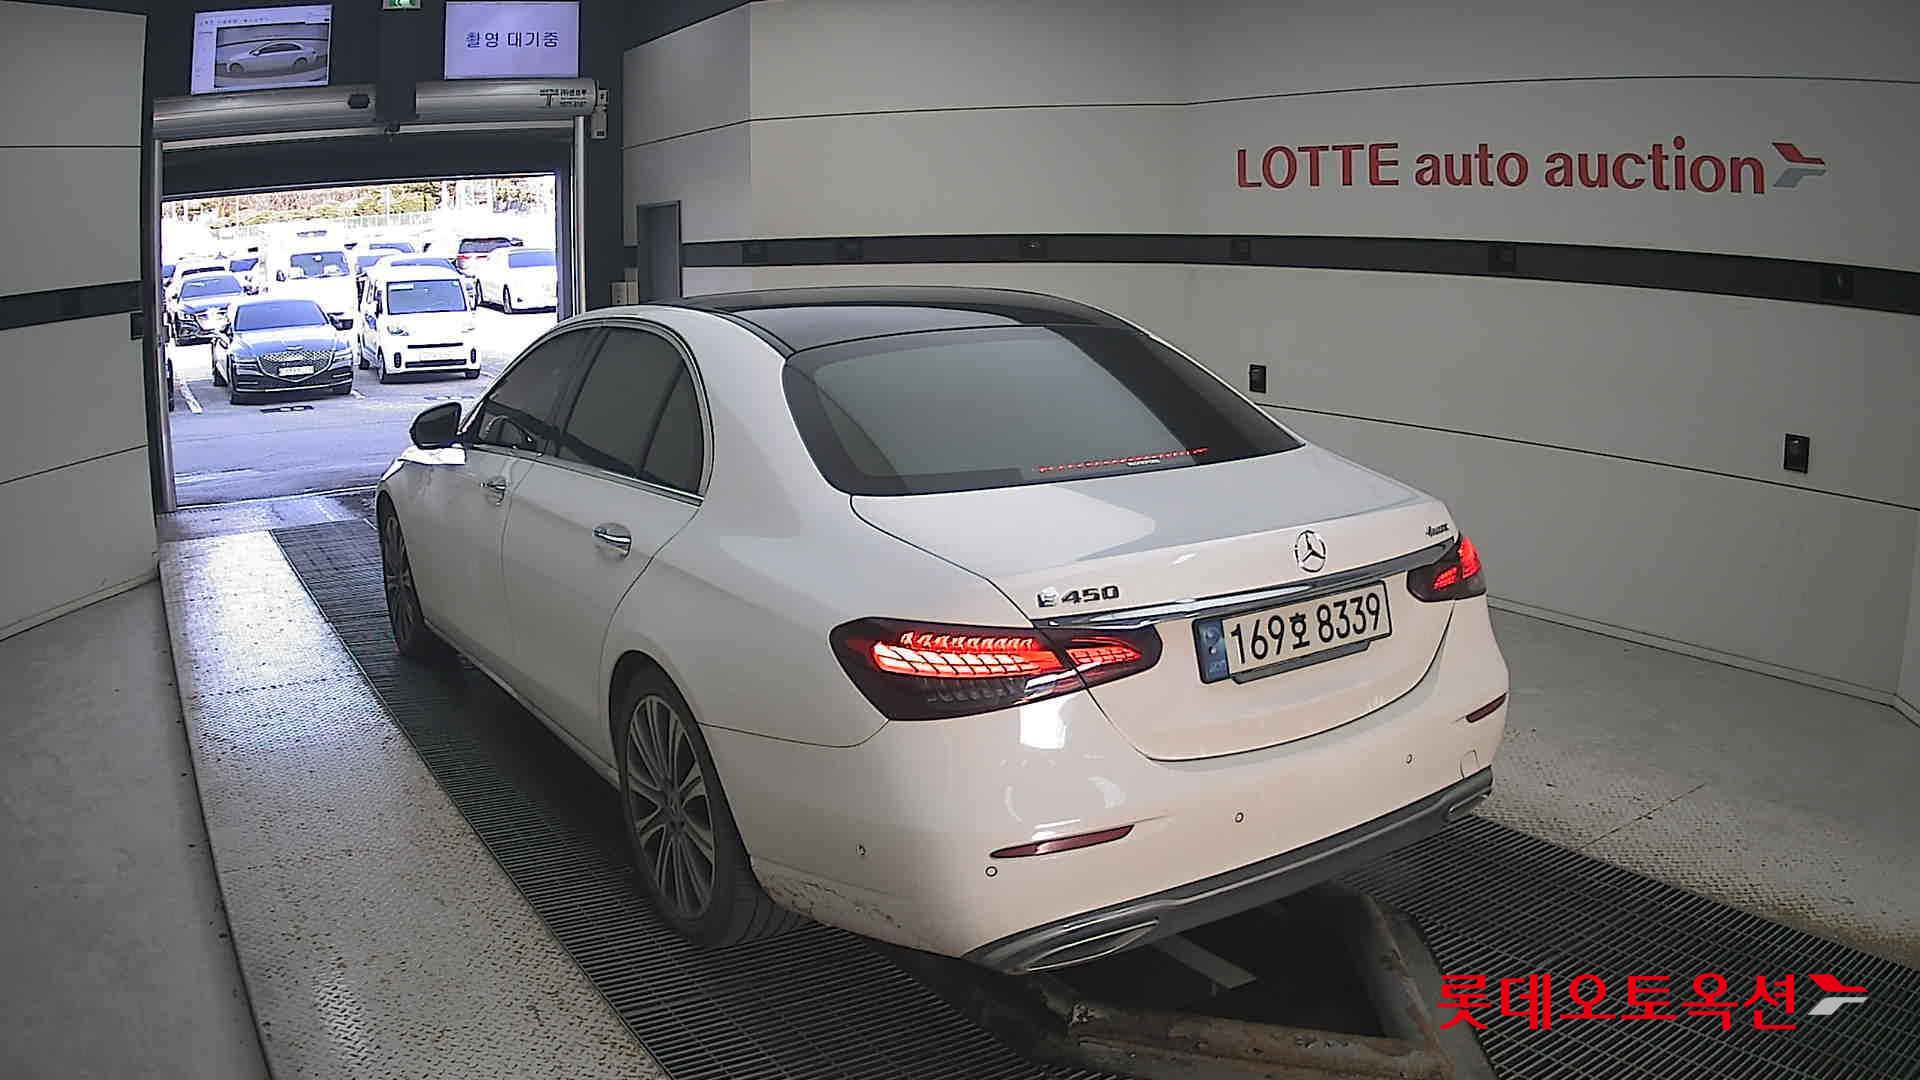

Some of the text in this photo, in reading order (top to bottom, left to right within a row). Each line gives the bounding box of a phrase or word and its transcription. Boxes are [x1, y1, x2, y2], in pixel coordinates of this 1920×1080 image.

[466, 31, 560, 48] 촬영 대기중
[1237, 135, 1765, 194] LOTTE auto auction
[1037, 585, 1120, 608] E 450
